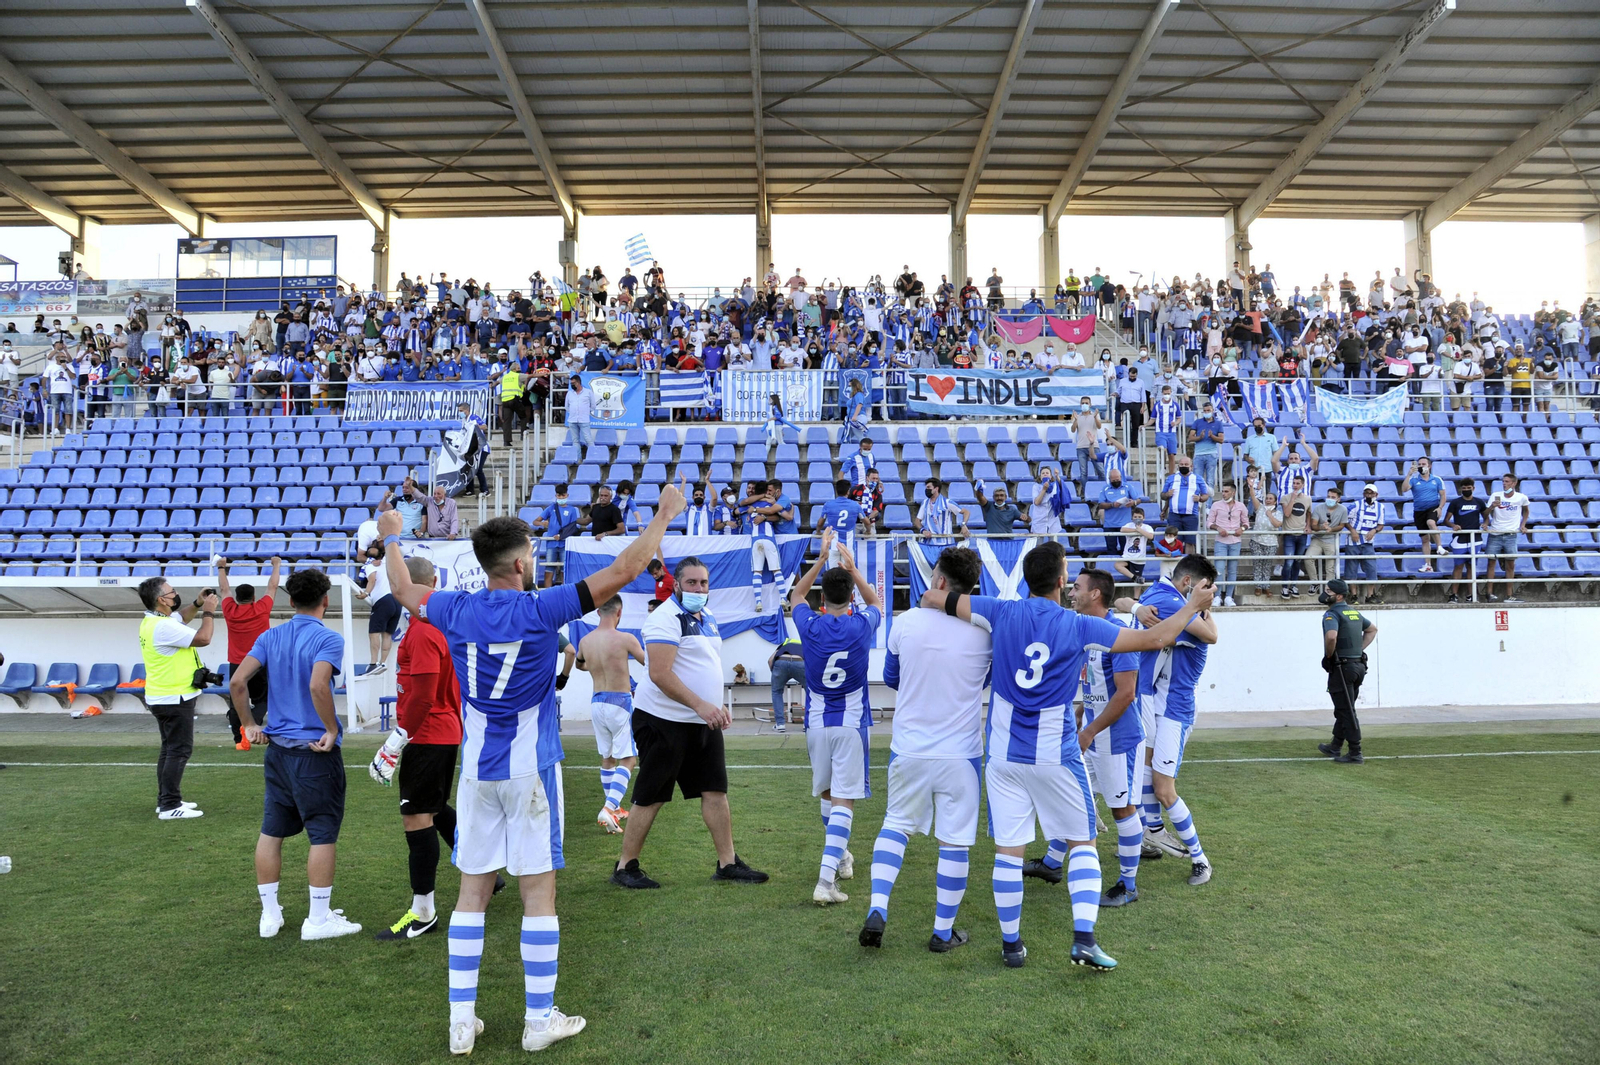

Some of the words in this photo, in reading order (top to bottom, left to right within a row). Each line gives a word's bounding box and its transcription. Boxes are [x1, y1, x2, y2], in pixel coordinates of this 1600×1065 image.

[46, 304, 72, 312] 667
[732, 373, 752, 381] PEÑA
[754, 374, 812, 382] INDUSTRIALISTA
[909, 373, 928, 401] I
[956, 376, 1052, 406] INDUS
[344, 390, 388, 422] ETERNO
[389, 389, 426, 422] PEDRO
[724, 408, 768, 420] Siempre
[787, 408, 821, 418] Frente
[837, 509, 849, 527] 2
[460, 567, 485, 579] CAT
[466, 639, 524, 700] 17
[822, 651, 849, 689] 6
[1015, 641, 1050, 689] 3
